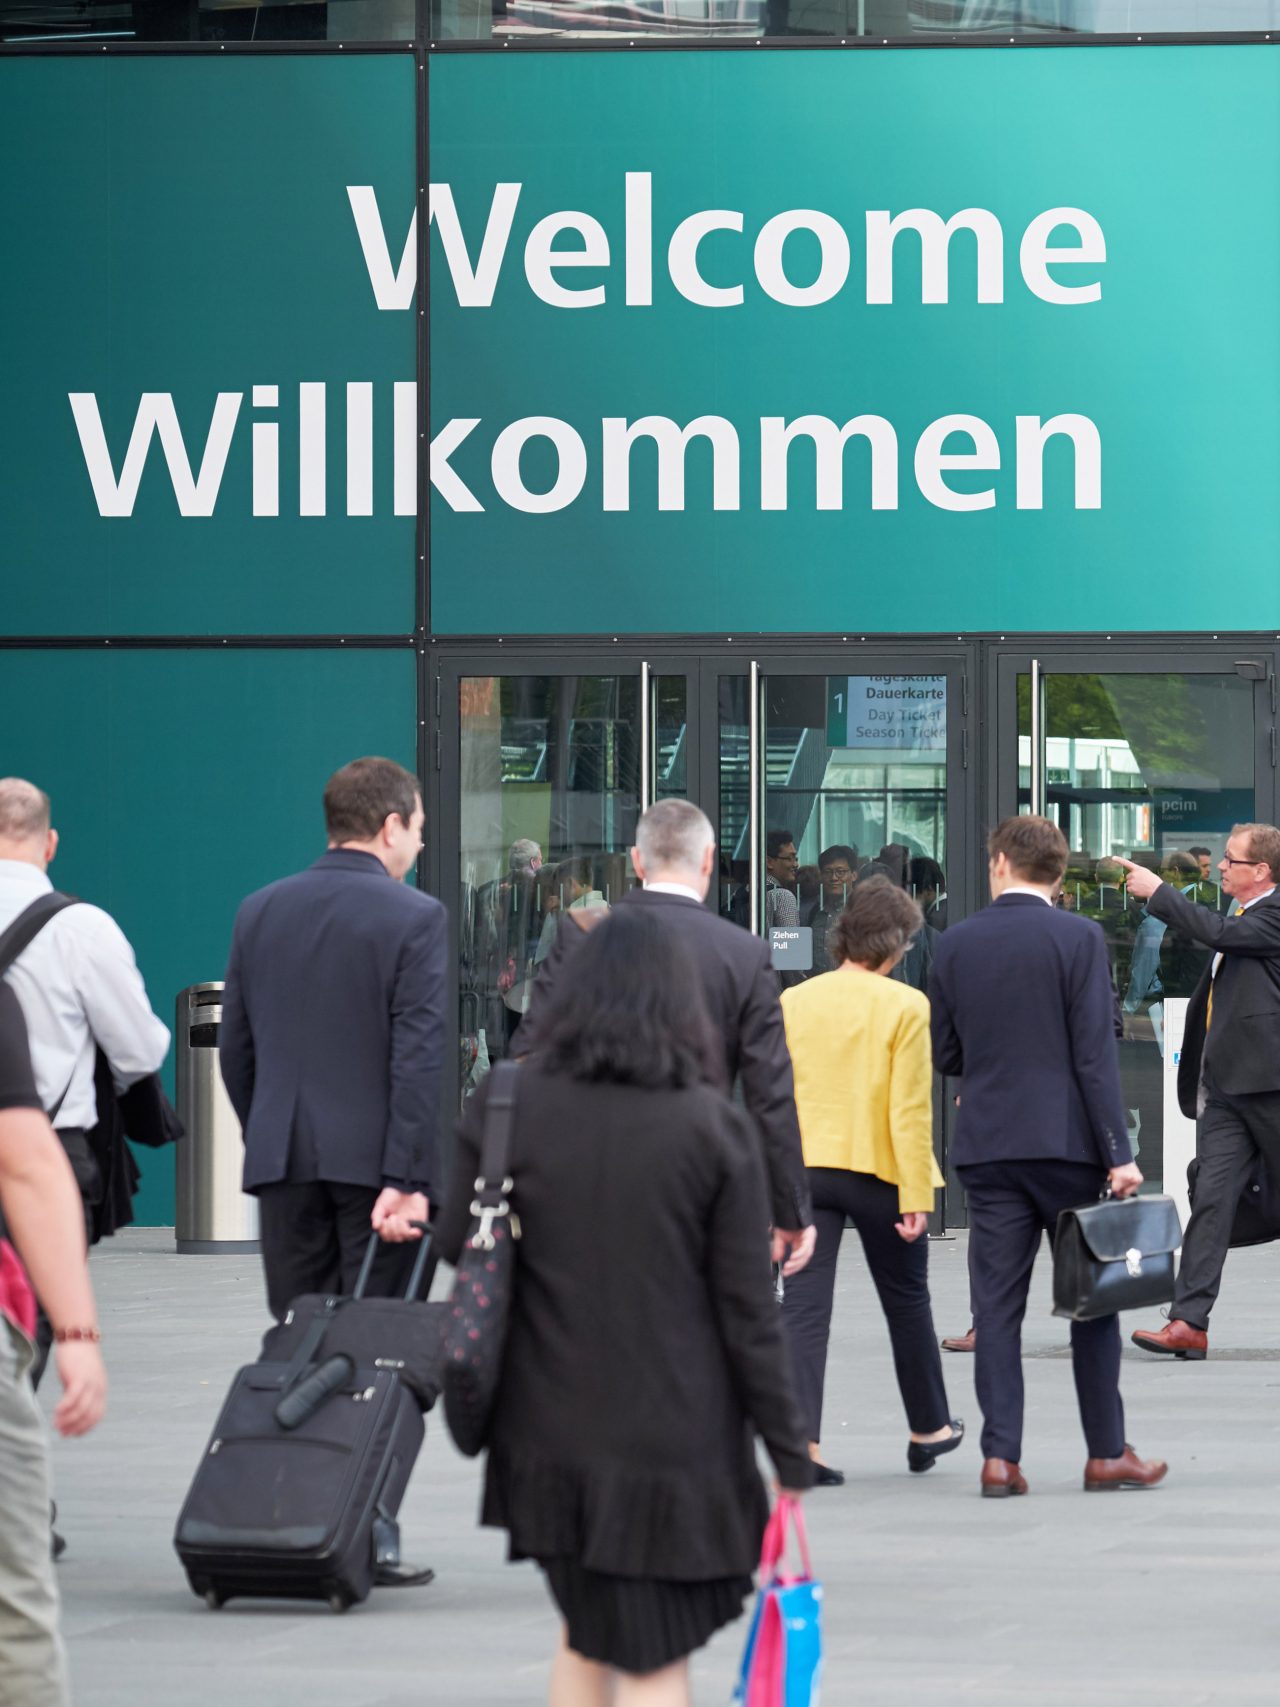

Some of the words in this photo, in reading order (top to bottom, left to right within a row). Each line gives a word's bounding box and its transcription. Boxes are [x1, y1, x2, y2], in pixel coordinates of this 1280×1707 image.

[346, 171, 1107, 310] Welcome
[68, 381, 1102, 517] Willkommen
[866, 687, 944, 700] Dauerkarte
[833, 692, 843, 714] 1
[868, 709, 895, 724] Day
[899, 709, 942, 721] Ticket
[856, 726, 905, 738] Season
[910, 726, 946, 739] Ticke
[1161, 796, 1198, 814] pcim
[773, 931, 799, 939] Ziehen
[773, 941, 788, 950] Pull
